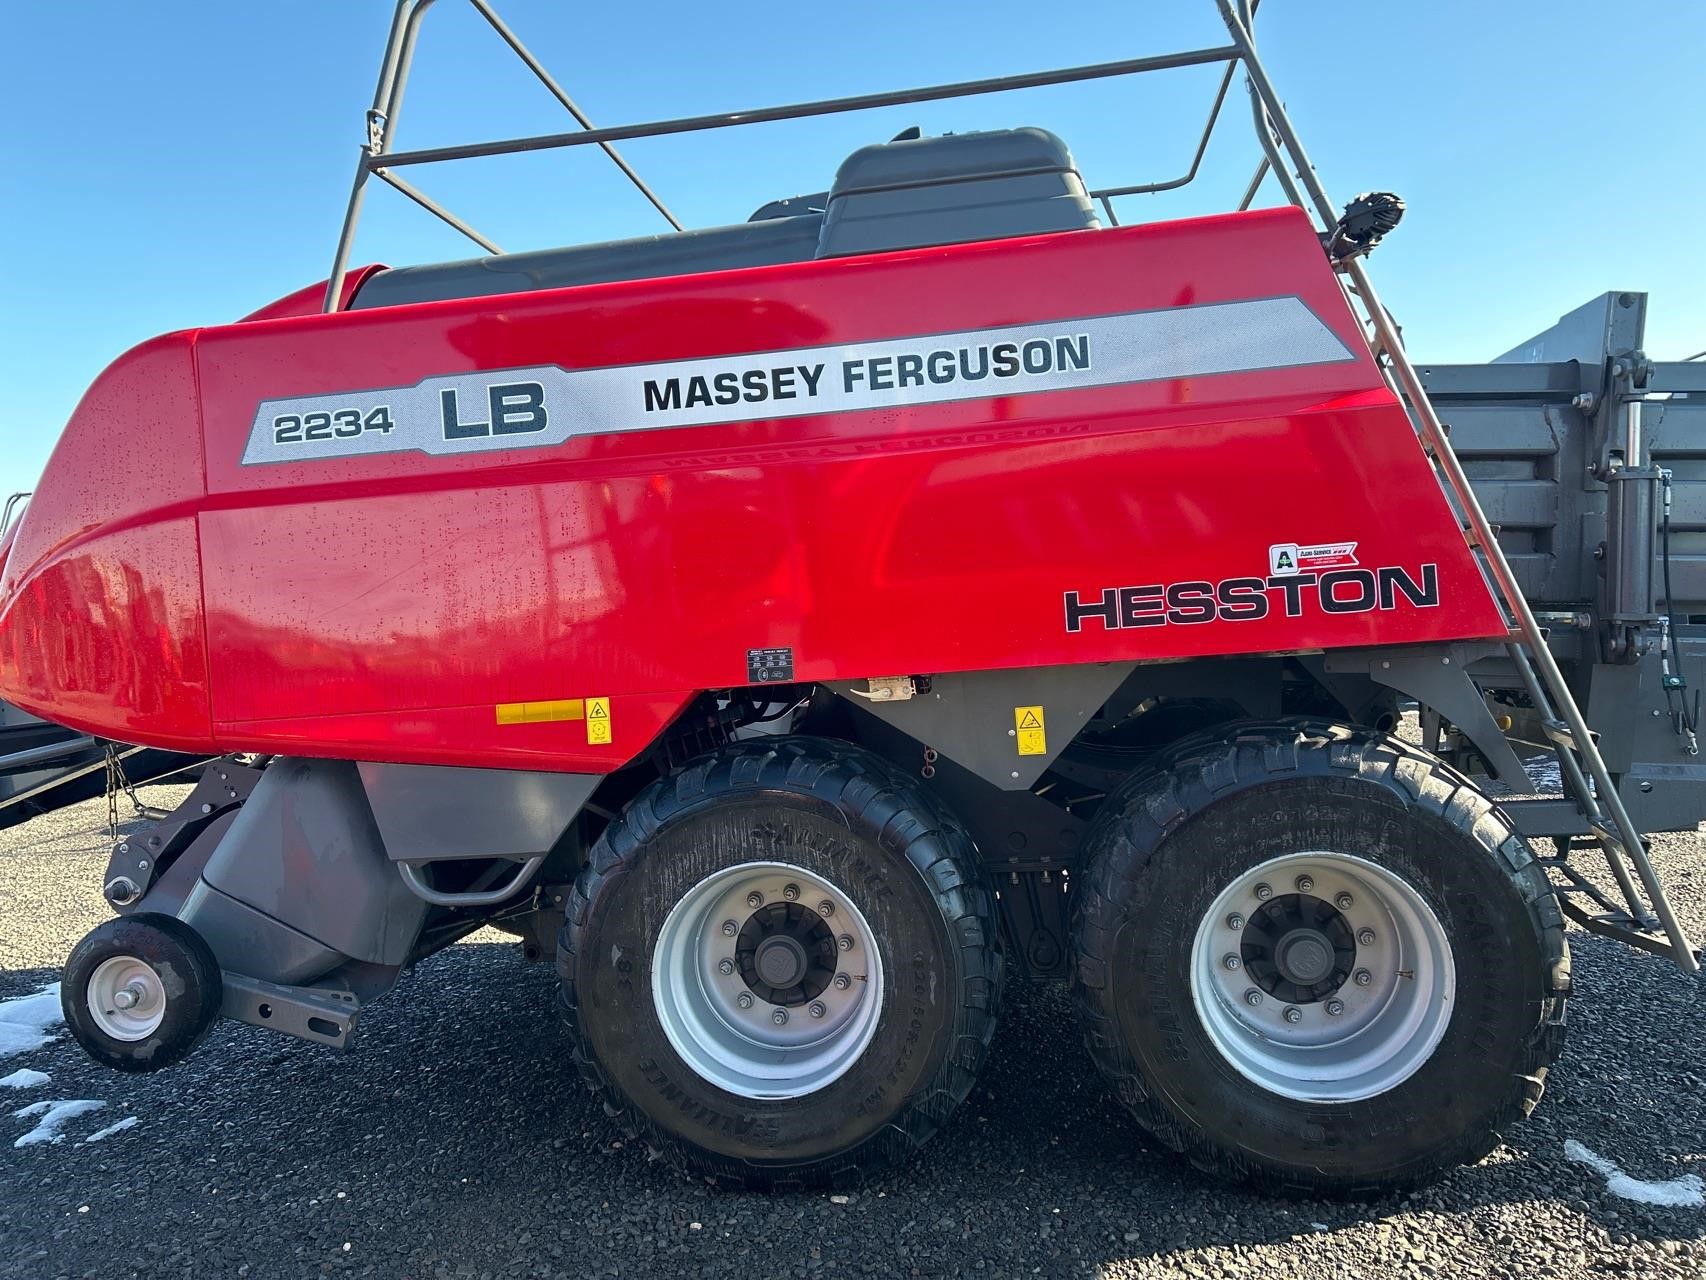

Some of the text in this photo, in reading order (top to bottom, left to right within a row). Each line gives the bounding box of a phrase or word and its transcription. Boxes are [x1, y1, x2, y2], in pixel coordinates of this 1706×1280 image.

[644, 333, 1091, 412] MASSEY FERGUSON
[273, 405, 394, 444] 2234
[439, 381, 548, 441] LB
[1064, 563, 1440, 633] HESSTON
